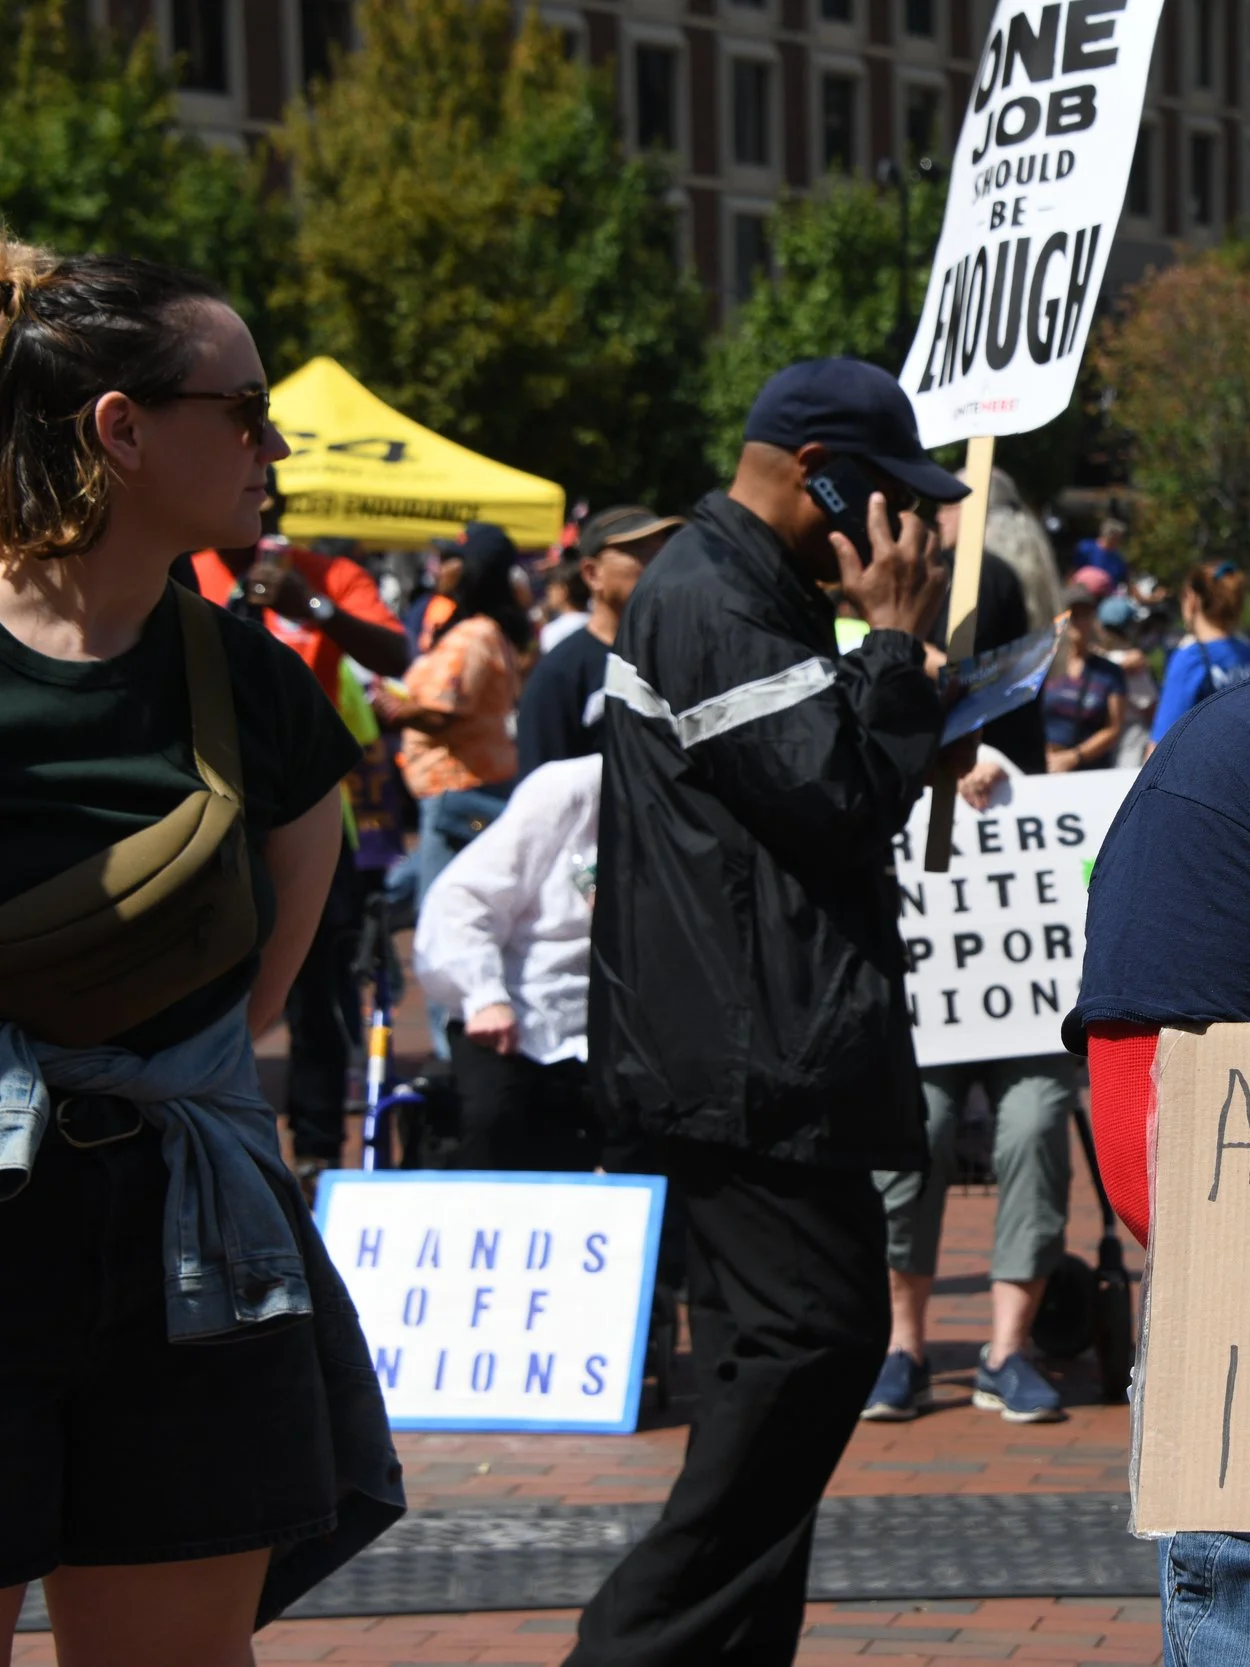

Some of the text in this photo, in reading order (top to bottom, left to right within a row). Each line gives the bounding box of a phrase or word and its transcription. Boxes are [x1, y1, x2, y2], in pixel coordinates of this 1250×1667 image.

[971, 0, 1127, 114] ONE
[972, 84, 1097, 165] JOB
[974, 149, 1076, 204] SHOULD
[990, 196, 1028, 231] BE
[917, 224, 1102, 394] ENOUGH
[891, 813, 1086, 861] RERS
[356, 1227, 609, 1274] HANDS
[401, 1286, 550, 1332] OFF
